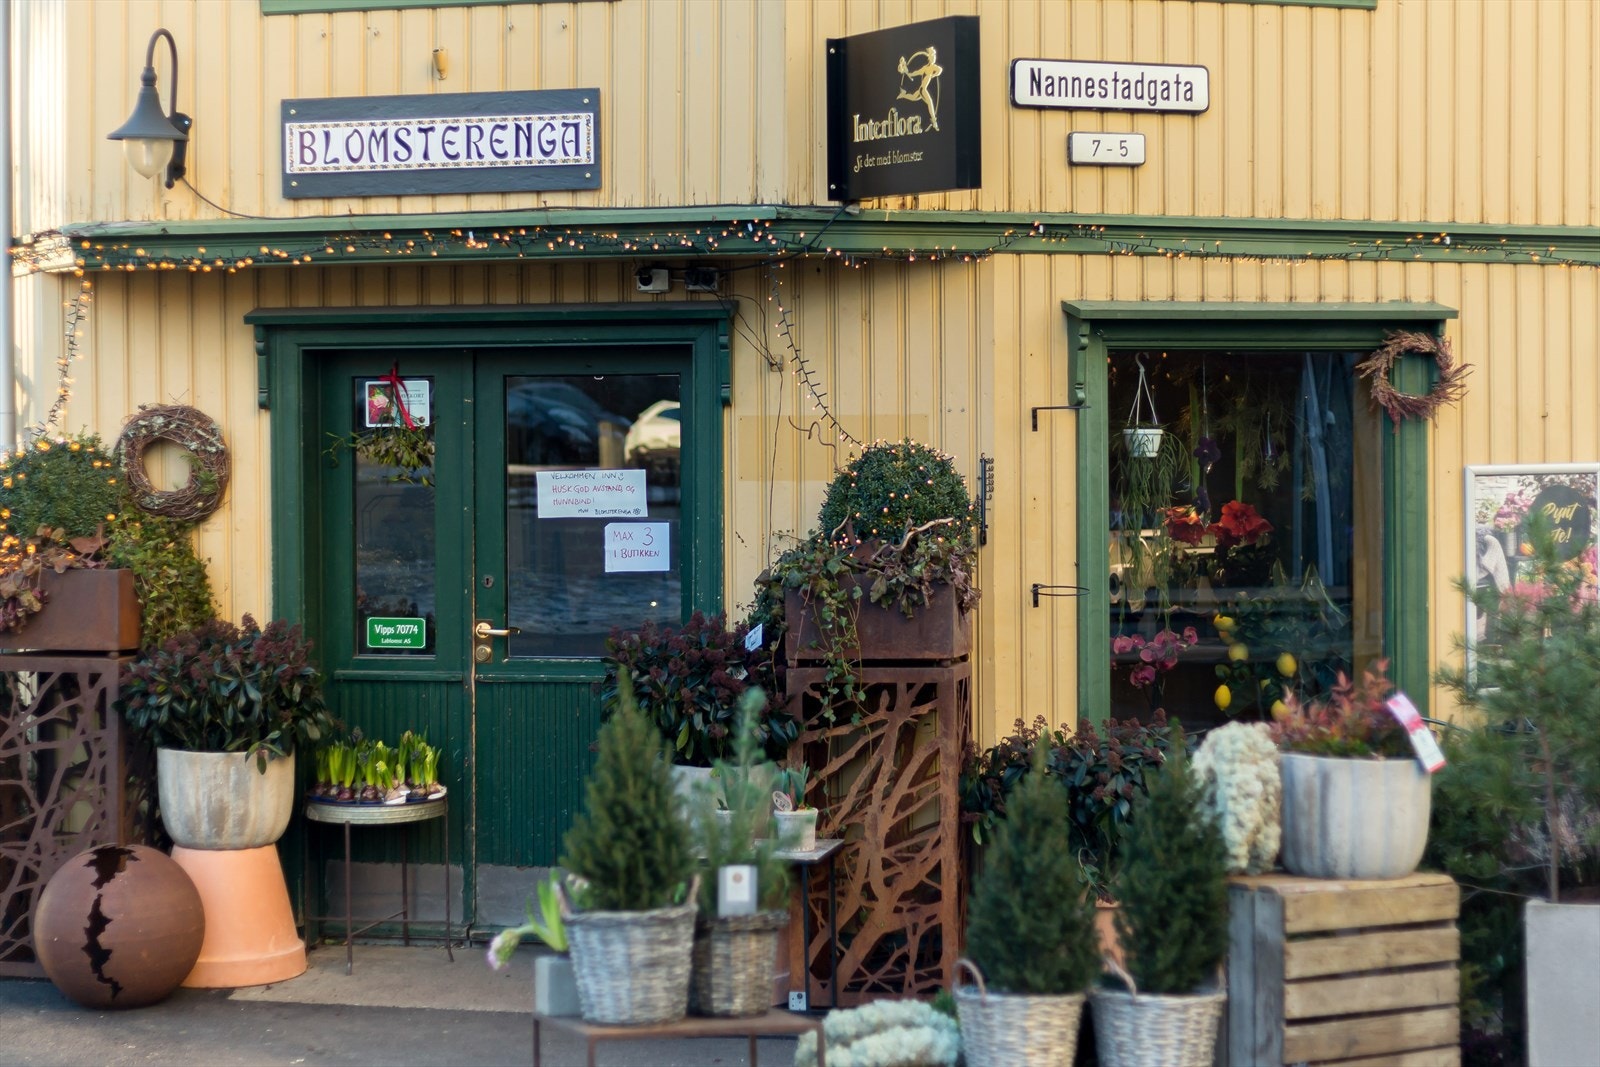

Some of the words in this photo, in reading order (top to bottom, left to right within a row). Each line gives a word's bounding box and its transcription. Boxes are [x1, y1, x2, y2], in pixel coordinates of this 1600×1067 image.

[1029, 67, 1194, 107] Nannestadgata
[853, 107, 923, 143] Interflora
[298, 121, 582, 166] BLOMSTERENGA
[864, 154, 876, 167] det
[876, 150, 891, 166] med
[892, 149, 924, 164] blomster
[551, 472, 596, 480] VELKOMMEN
[552, 484, 572, 493] HUSK
[573, 484, 590, 493] GOD
[625, 485, 635, 494] OG
[1541, 502, 1583, 525] Pynt
[613, 530, 634, 541] MAX
[642, 527, 654, 547] 3
[620, 548, 660, 559] BUTIKKEN
[374, 624, 395, 636] Vipps
[396, 624, 418, 634] 70774
